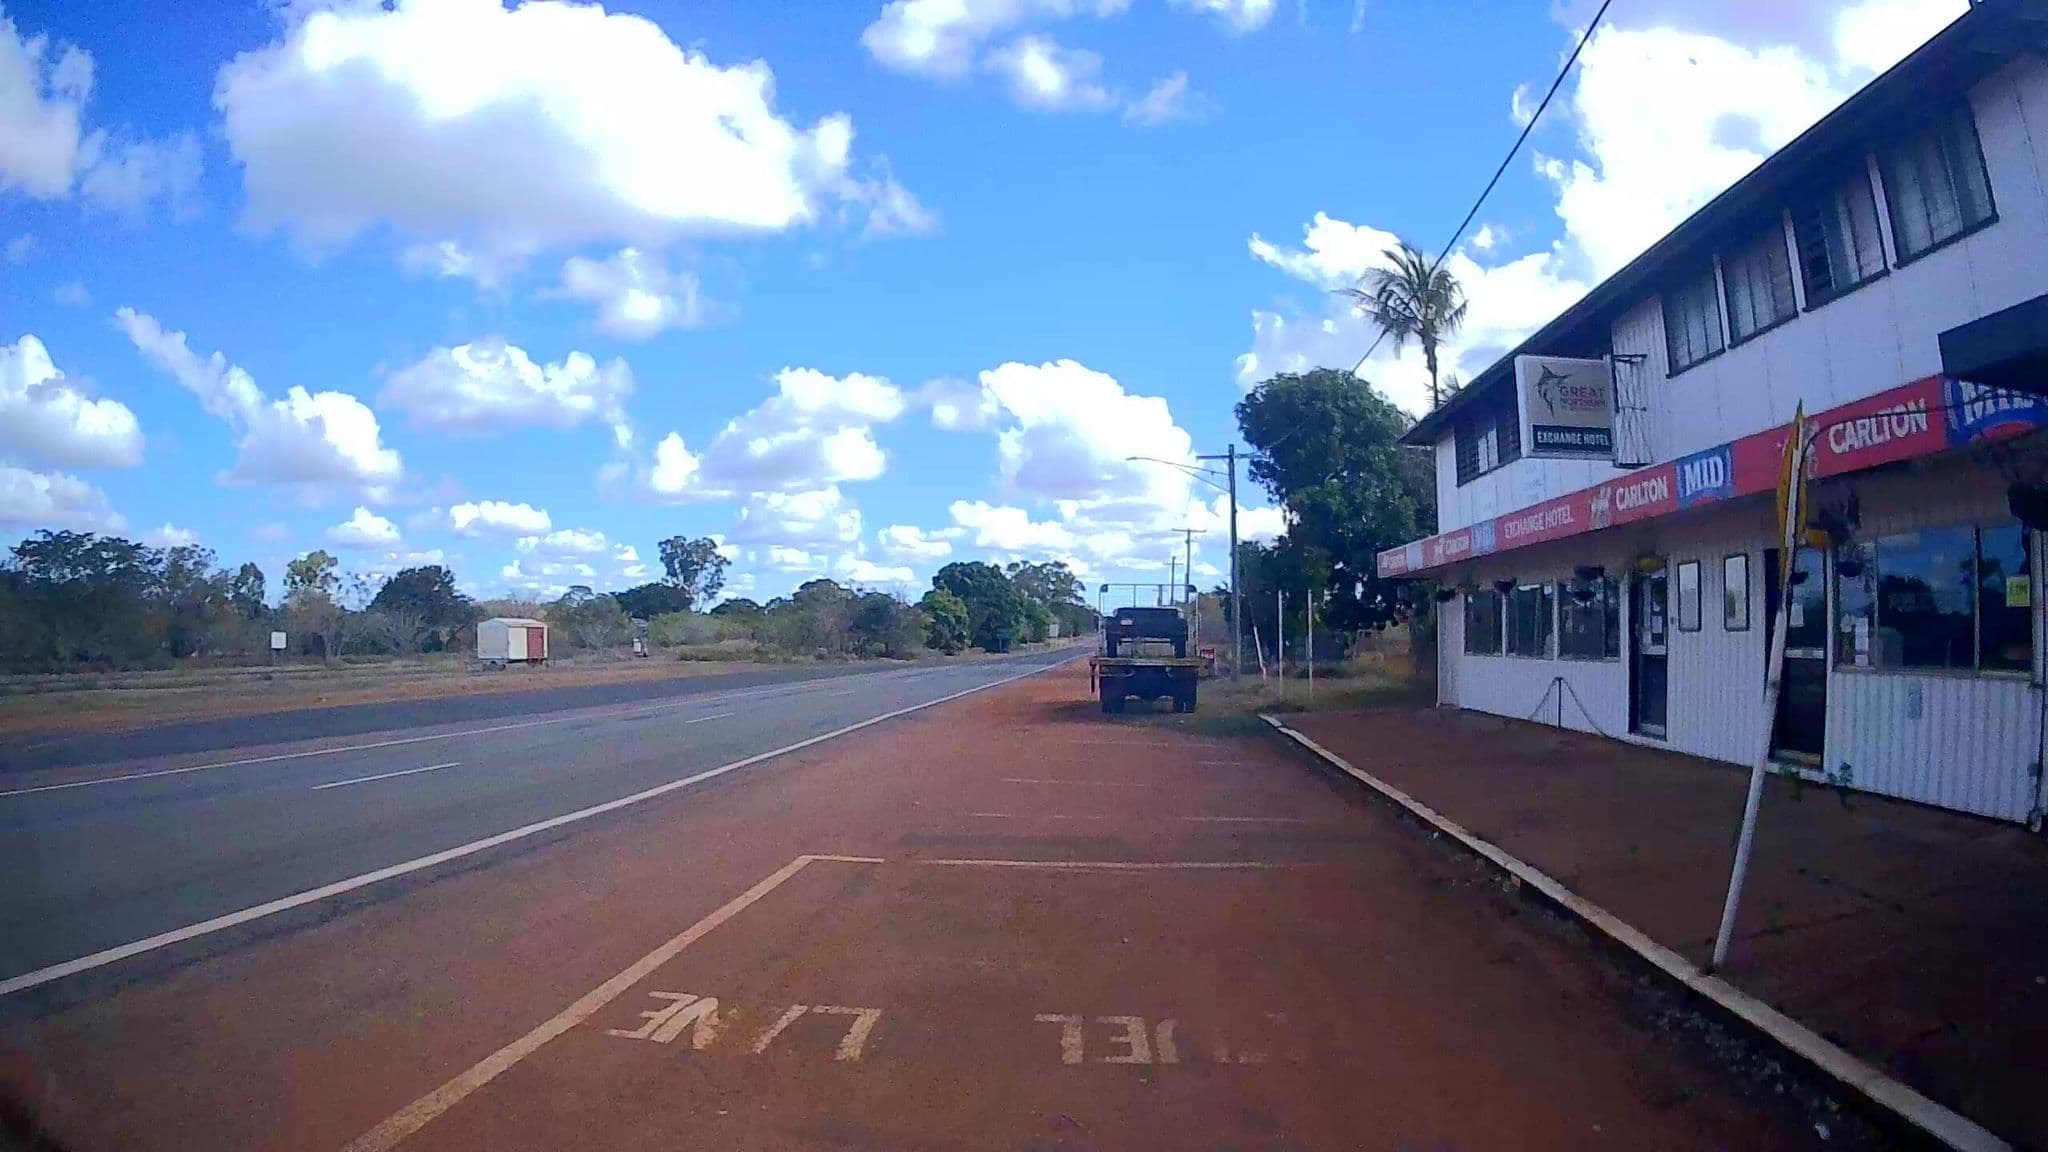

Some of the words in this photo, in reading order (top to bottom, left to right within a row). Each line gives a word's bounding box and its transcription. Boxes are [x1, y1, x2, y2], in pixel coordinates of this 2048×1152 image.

[1560, 385, 1606, 398] GREAT
[1537, 431, 1582, 445] EXCHANGE
[1584, 433, 1610, 446] HOTEL
[1828, 398, 1928, 455] CARLTON
[1615, 475, 1669, 512] CARLTON
[1684, 456, 1724, 497] MID
[1504, 510, 1545, 539] EXCHANGE
[1545, 504, 1575, 530] HOTEL
